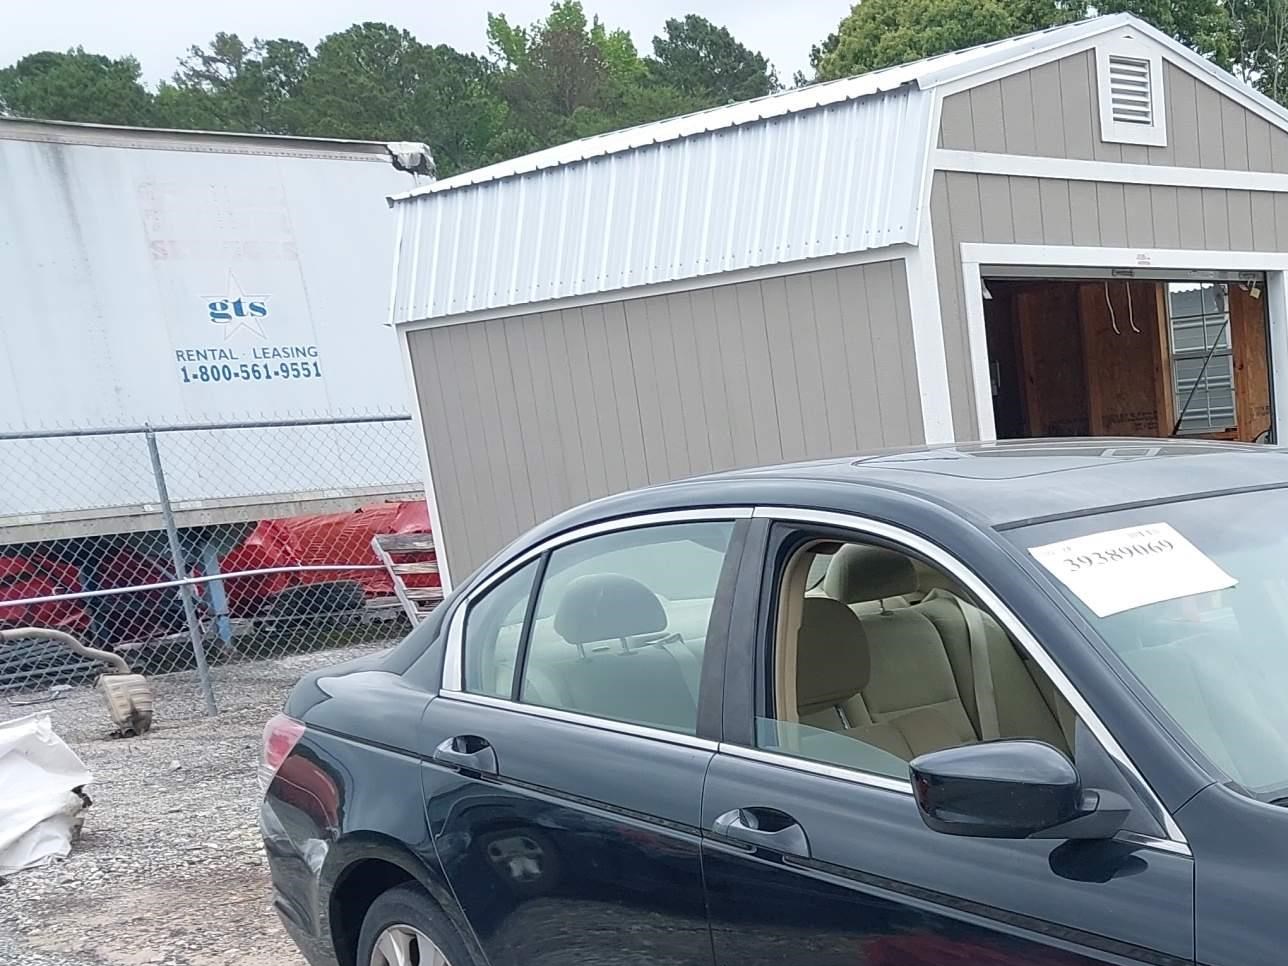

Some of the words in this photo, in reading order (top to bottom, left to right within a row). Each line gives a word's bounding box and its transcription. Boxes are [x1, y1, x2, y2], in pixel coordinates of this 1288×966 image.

[208, 297, 267, 324] gts
[175, 348, 239, 363] RENTAL
[252, 346, 319, 361] LEASING
[180, 361, 322, 383] 1-800-561-9551
[1063, 538, 1174, 572] 39389069
